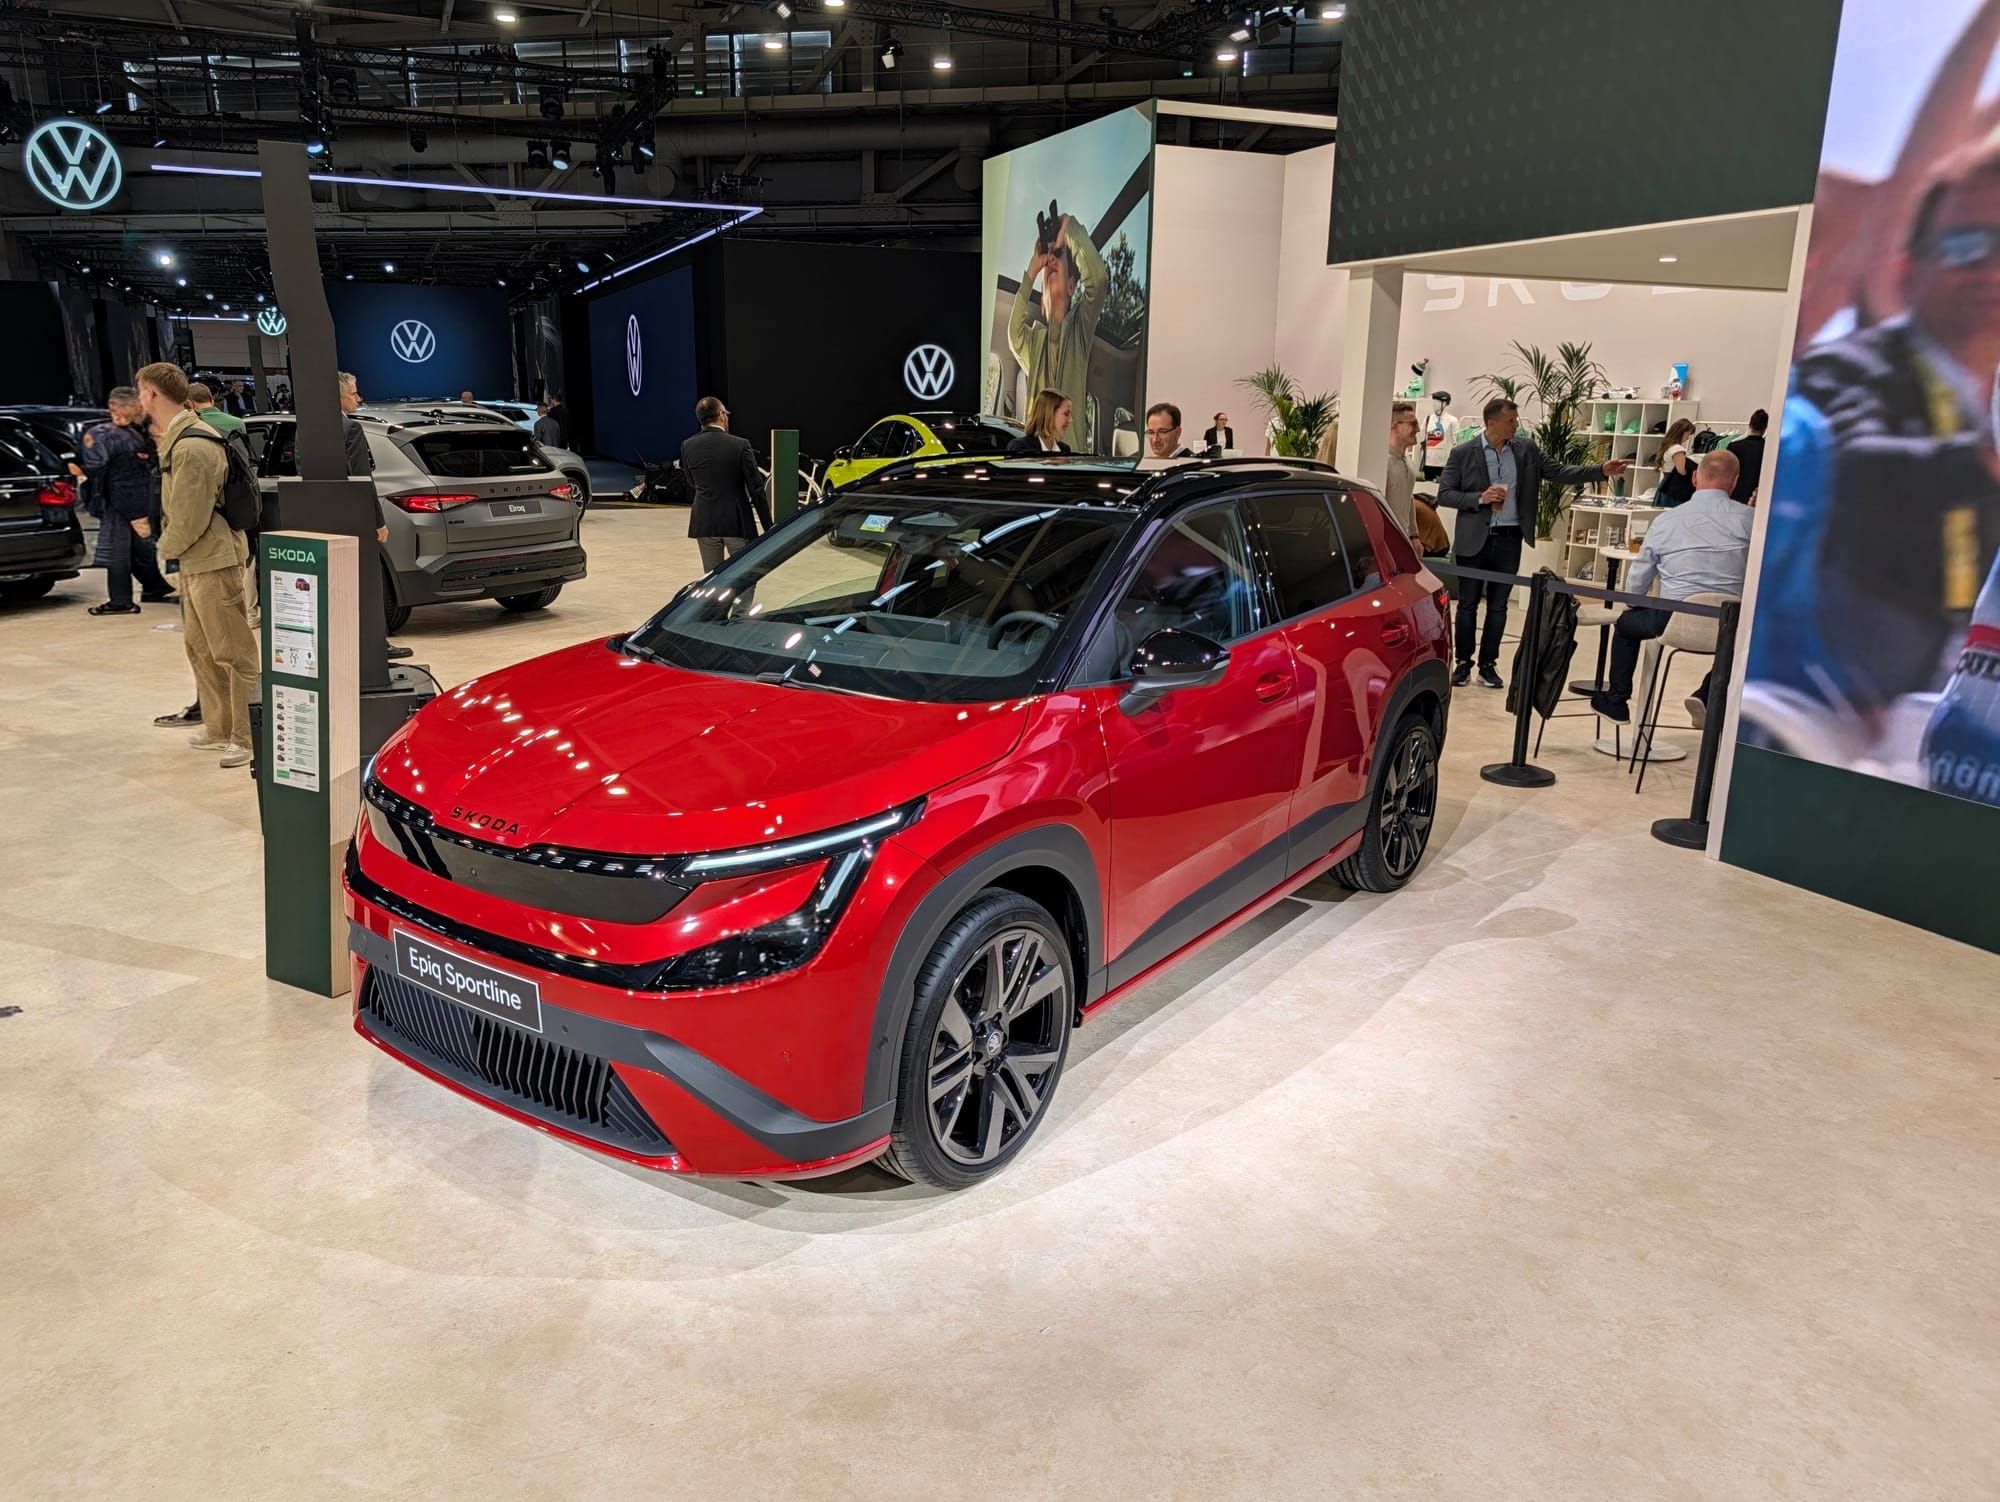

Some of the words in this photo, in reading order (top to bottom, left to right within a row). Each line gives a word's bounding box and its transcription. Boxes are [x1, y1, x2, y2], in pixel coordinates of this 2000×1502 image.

[508, 504, 526, 513] Elroq
[268, 547, 316, 564] SKODA
[451, 807, 519, 834] SKODA
[408, 946, 444, 985] Epiq
[445, 963, 522, 1010] Sportline
